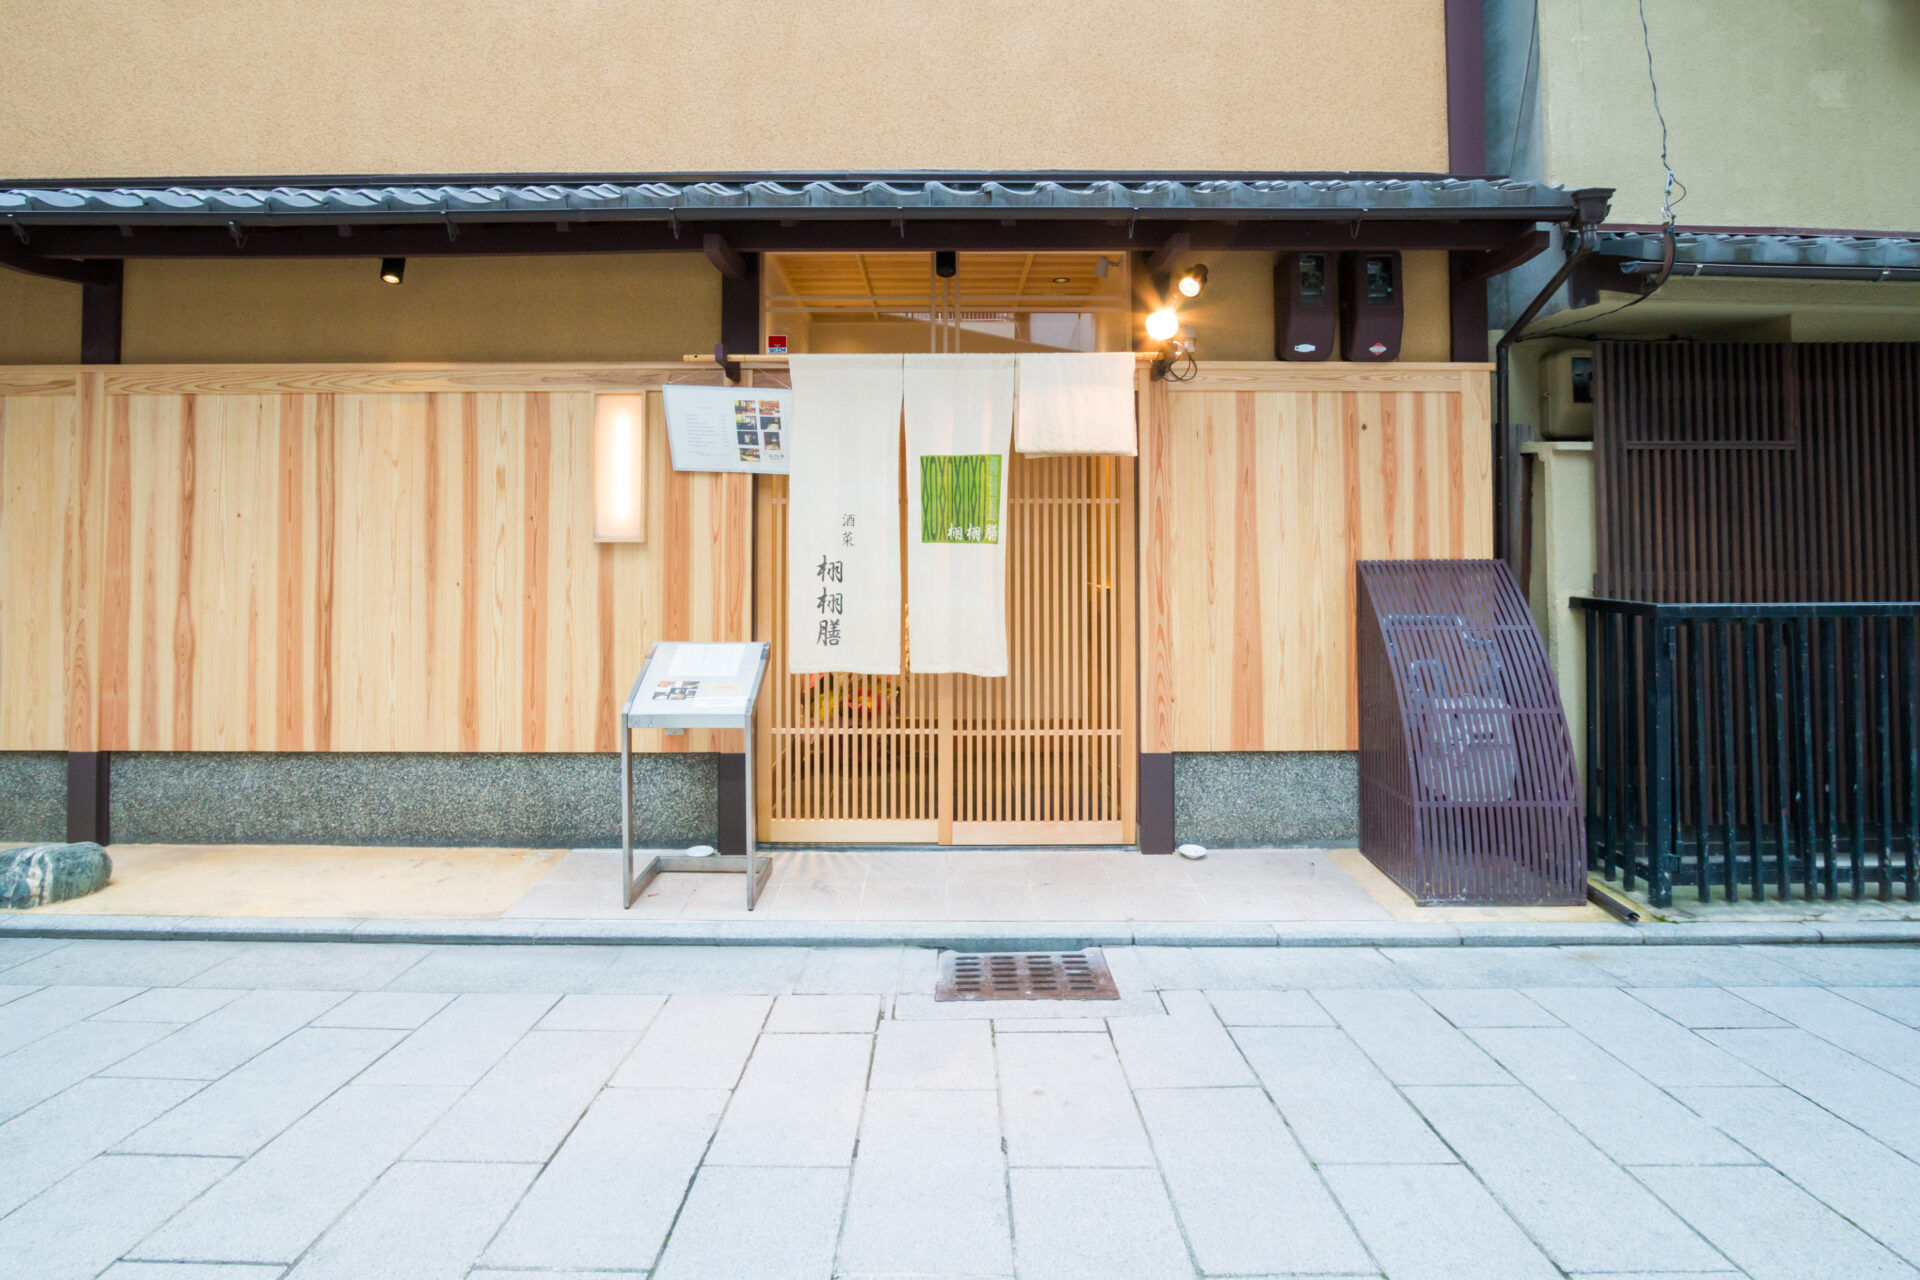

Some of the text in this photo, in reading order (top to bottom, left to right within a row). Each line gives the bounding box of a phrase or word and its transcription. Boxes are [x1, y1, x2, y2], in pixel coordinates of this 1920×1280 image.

[842, 513, 855, 547] 酒菜
[816, 554, 843, 646] 栩栩膳
